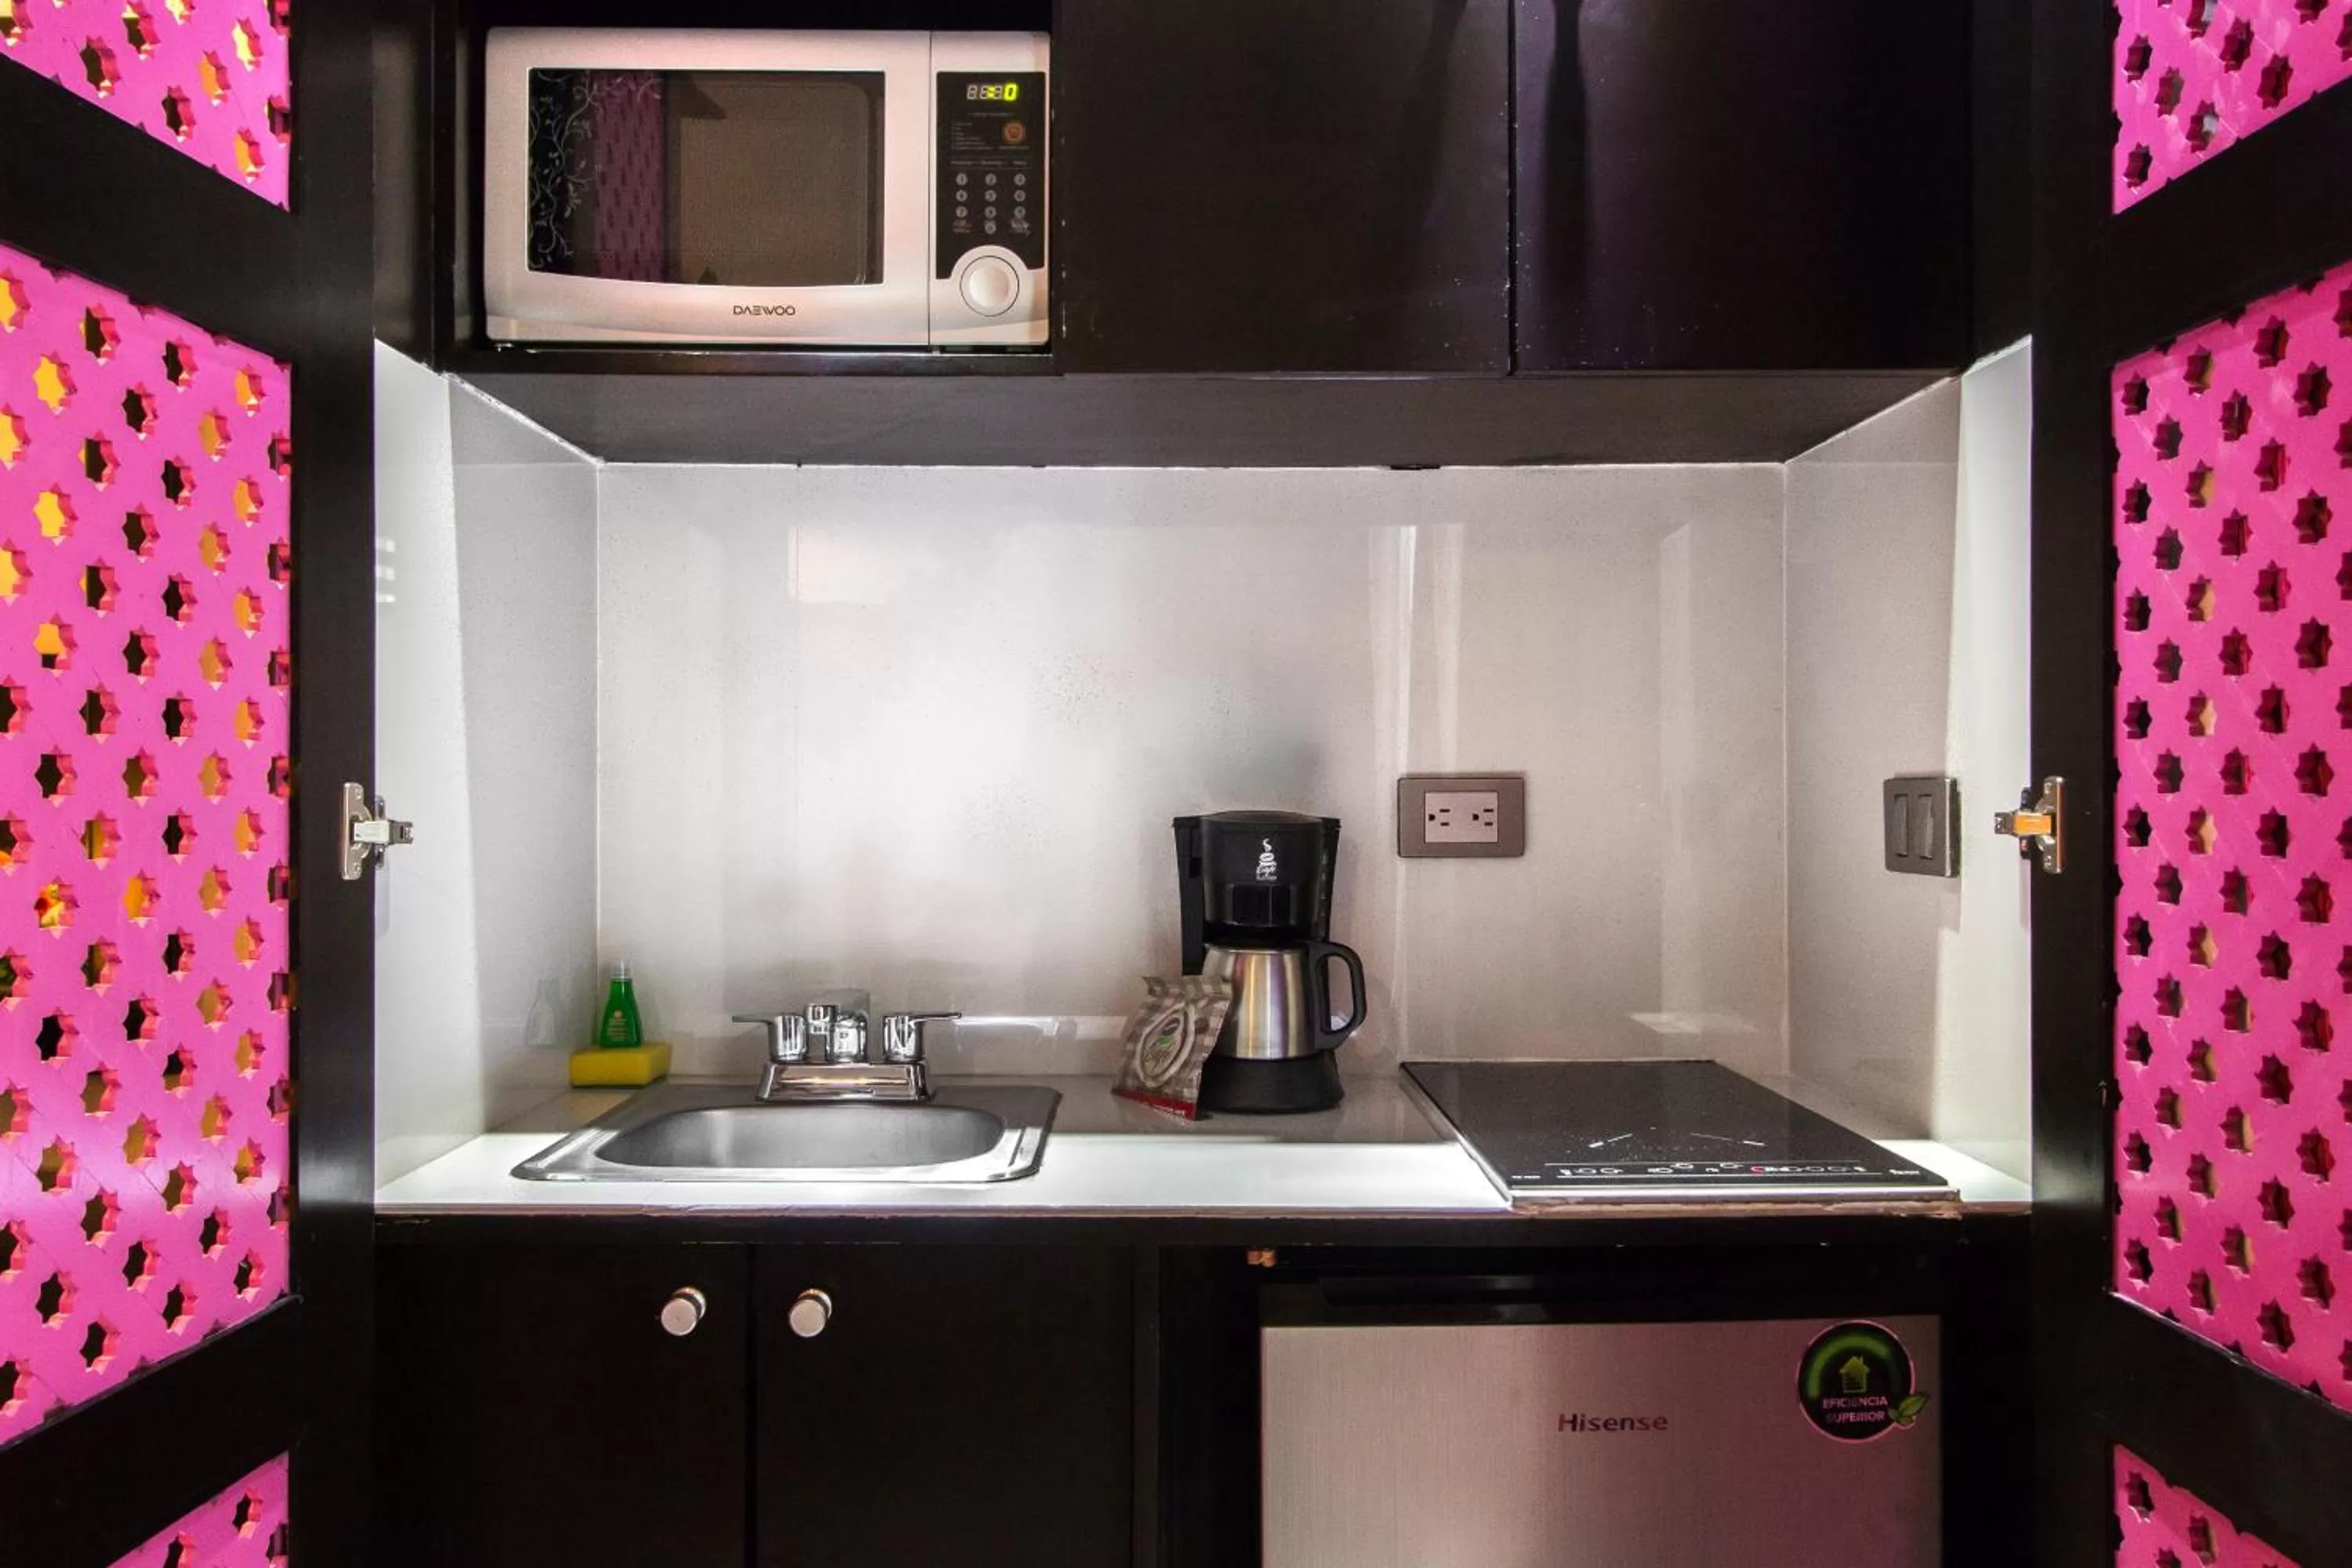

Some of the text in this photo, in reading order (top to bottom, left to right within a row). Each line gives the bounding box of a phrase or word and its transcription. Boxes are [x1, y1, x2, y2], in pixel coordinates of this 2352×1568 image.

[733, 305, 796, 315] DAEWOO
[1823, 1396, 1888, 1409] EFICIENCIA
[1558, 1412, 1668, 1432] Hisense
[1826, 1410, 1886, 1423] SUPERIOR
